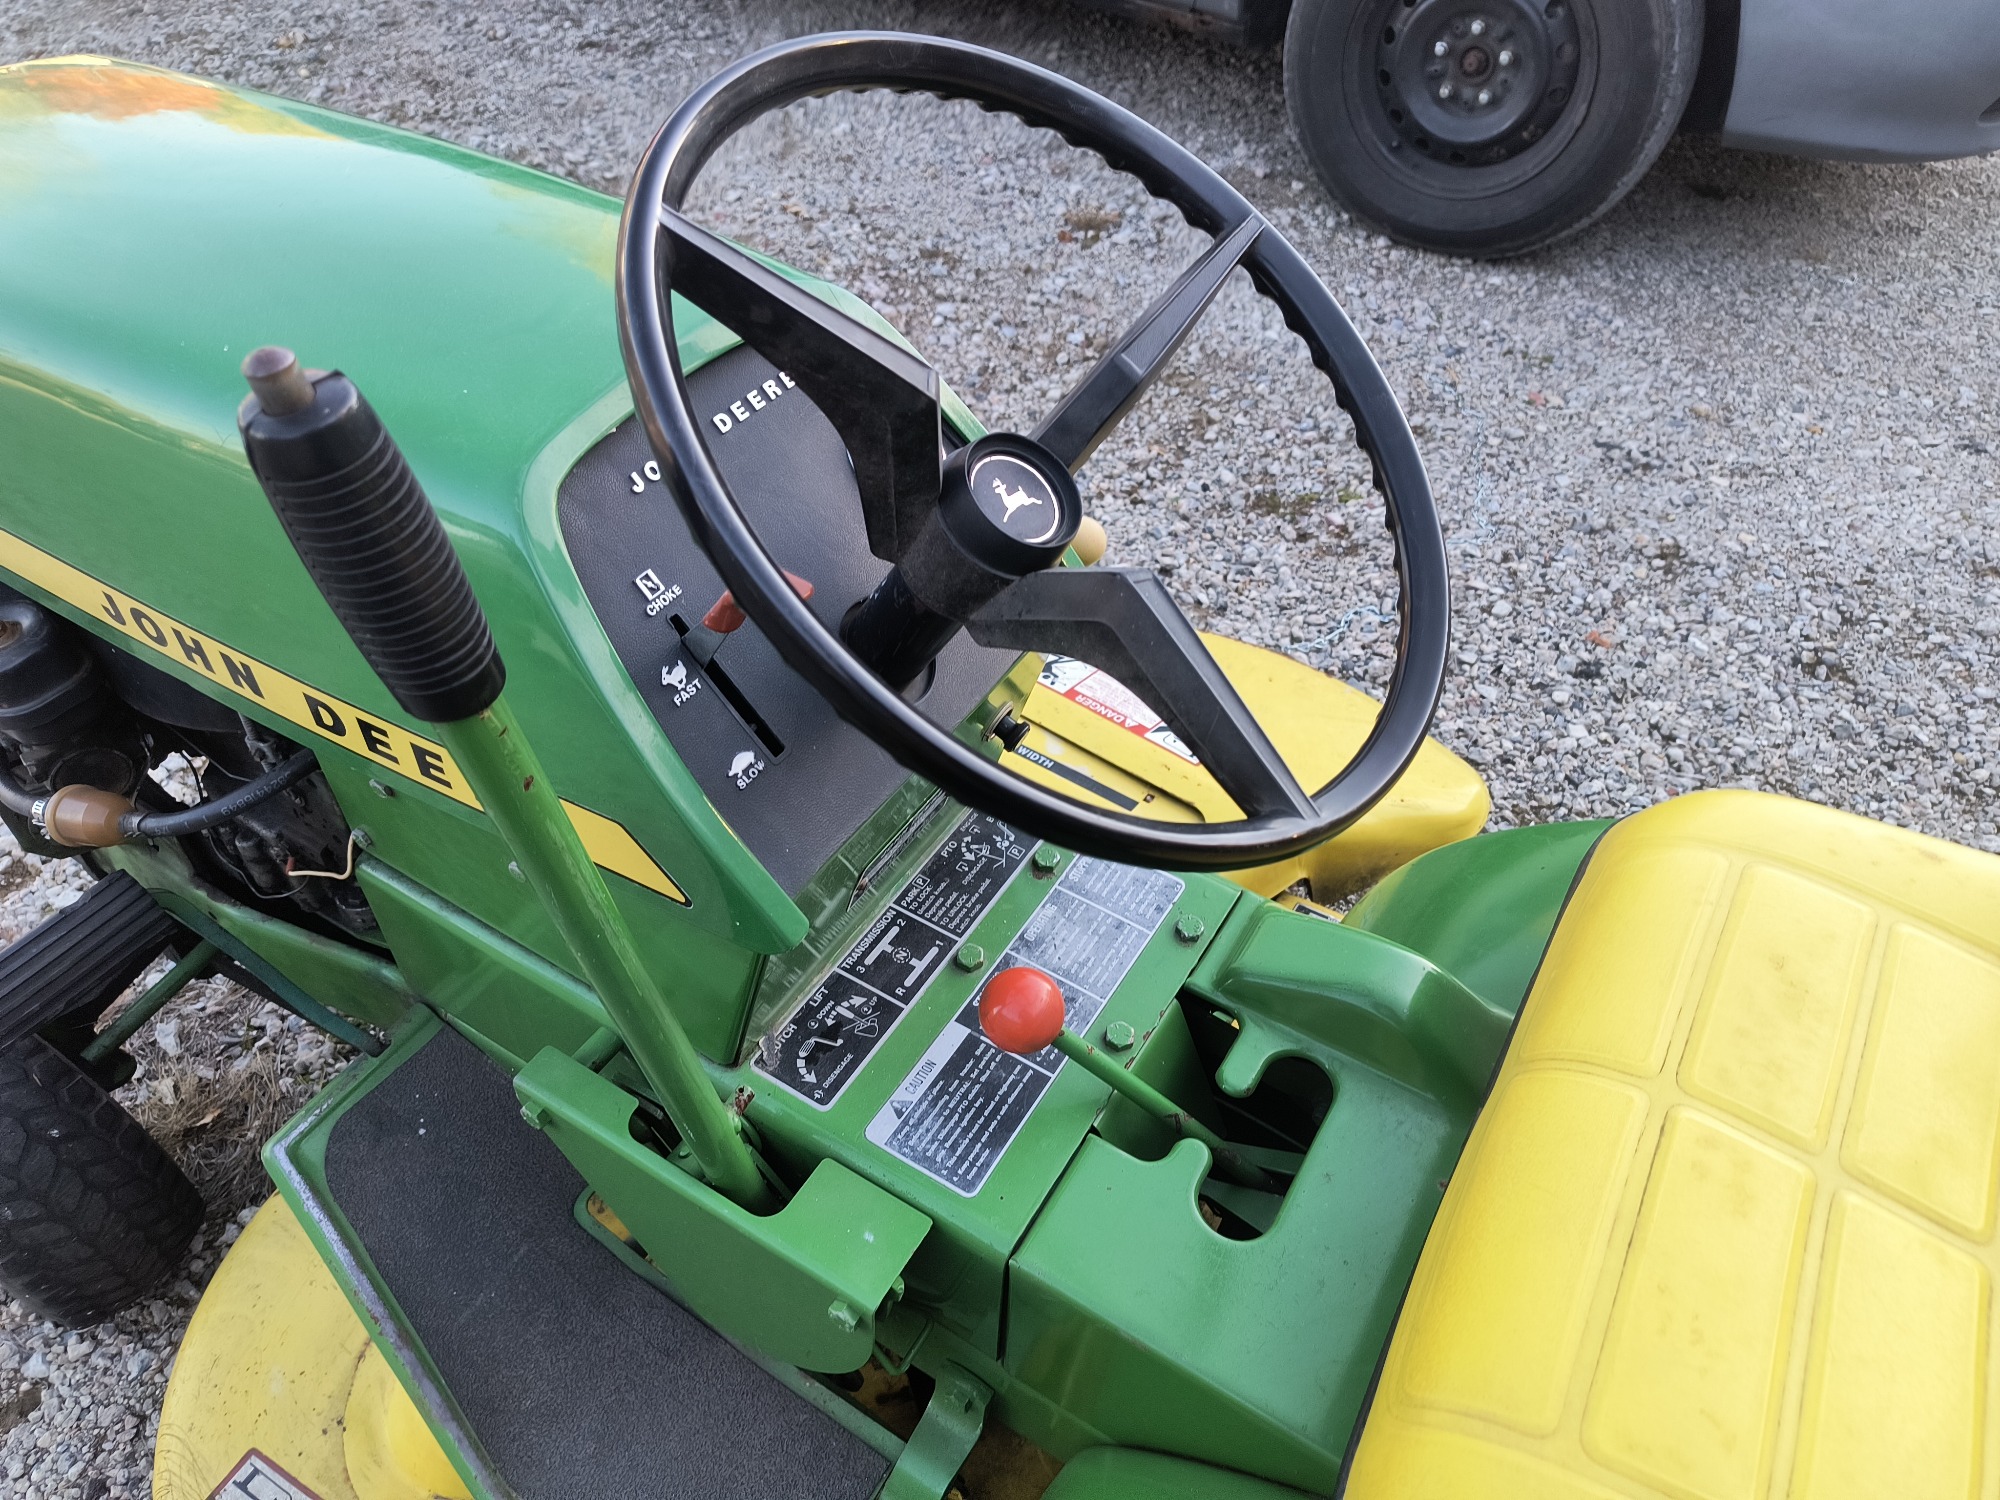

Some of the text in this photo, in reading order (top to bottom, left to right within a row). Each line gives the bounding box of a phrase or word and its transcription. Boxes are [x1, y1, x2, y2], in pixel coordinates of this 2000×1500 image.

[630, 370, 797, 493] JO DEERE
[646, 583, 683, 617] CHOKE
[101, 590, 454, 790] JOHN DEE
[673, 677, 703, 707] FAST
[1075, 694, 1127, 724] DANGER
[1017, 745, 1055, 769] WIDTH
[736, 758, 765, 791] SLOW
[959, 811, 979, 831] ENGAGE
[940, 840, 958, 857] PTO
[961, 856, 988, 885] DISENGAGE
[899, 886, 921, 907] PARK
[908, 883, 934, 911] TO LOCK:
[924, 896, 945, 918] Depress
[939, 892, 970, 926] TO UNLOCK:
[947, 906, 969, 929] Depress
[964, 891, 980, 908] brake
[897, 918, 907, 927] 2
[931, 906, 947, 922] brake
[955, 916, 971, 933] Latch
[1022, 902, 1058, 941] OPERATING
[840, 908, 898, 970] TRANSMISSION
[856, 965, 866, 974] 3
[808, 985, 830, 1007] LIFT
[868, 995, 880, 1006] UP
[895, 988, 906, 997] R
[815, 999, 835, 1019] DOWN
[774, 1023, 798, 1054] UTCH
[821, 1051, 854, 1088] DISENGAGE
[903, 1058, 937, 1095] CAUTION
[956, 1099, 969, 1113] PTO
